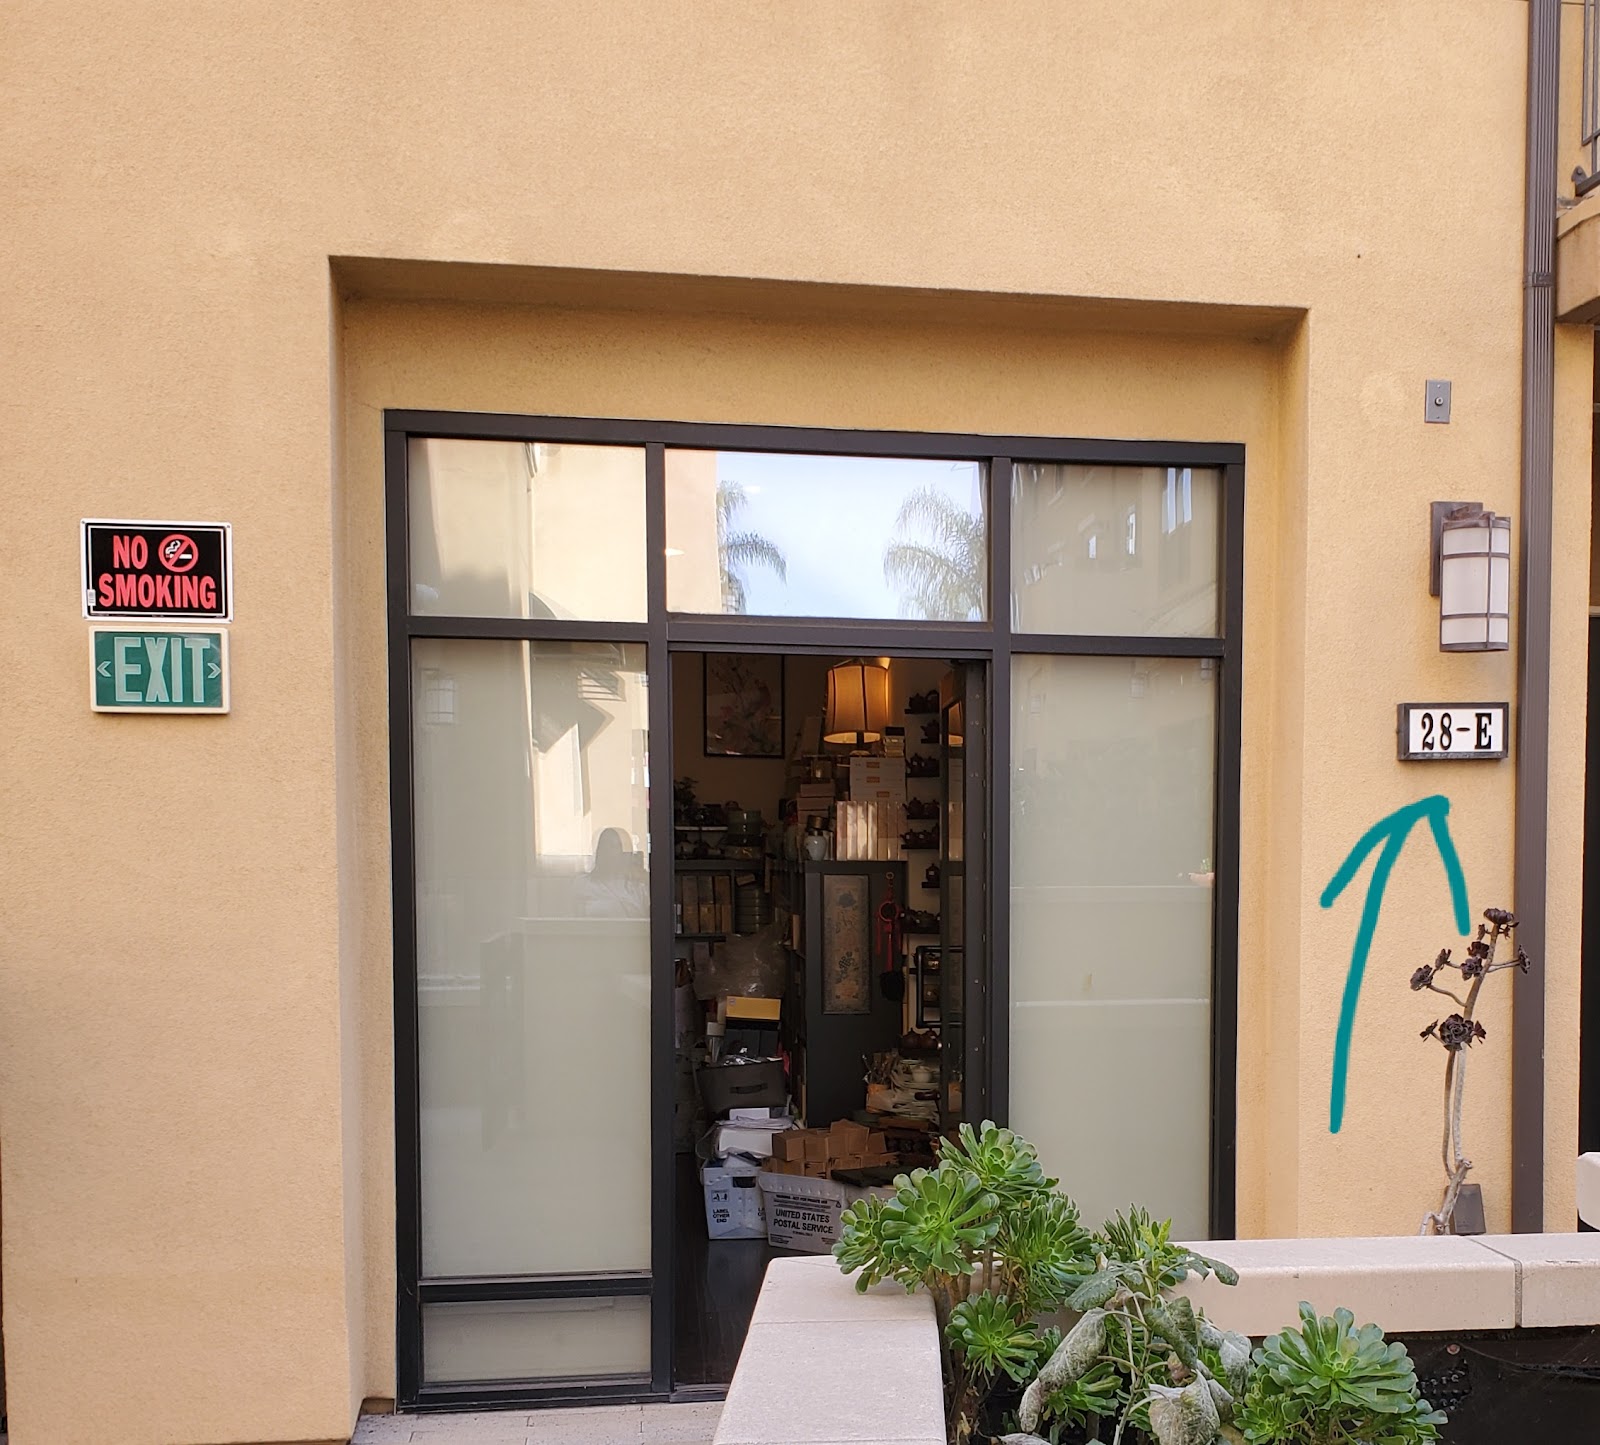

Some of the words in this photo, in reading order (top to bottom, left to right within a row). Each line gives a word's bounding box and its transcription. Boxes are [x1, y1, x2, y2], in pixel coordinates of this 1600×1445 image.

[112, 535, 149, 570] NO
[98, 573, 217, 610] SMOKING
[113, 636, 211, 703] EXIT
[1421, 712, 1492, 751] 28-E
[773, 1218, 801, 1230] POSTAL
[802, 1222, 834, 1234] SERVICE
[775, 1208, 801, 1219] UNITED
[802, 1212, 830, 1223] STATES
